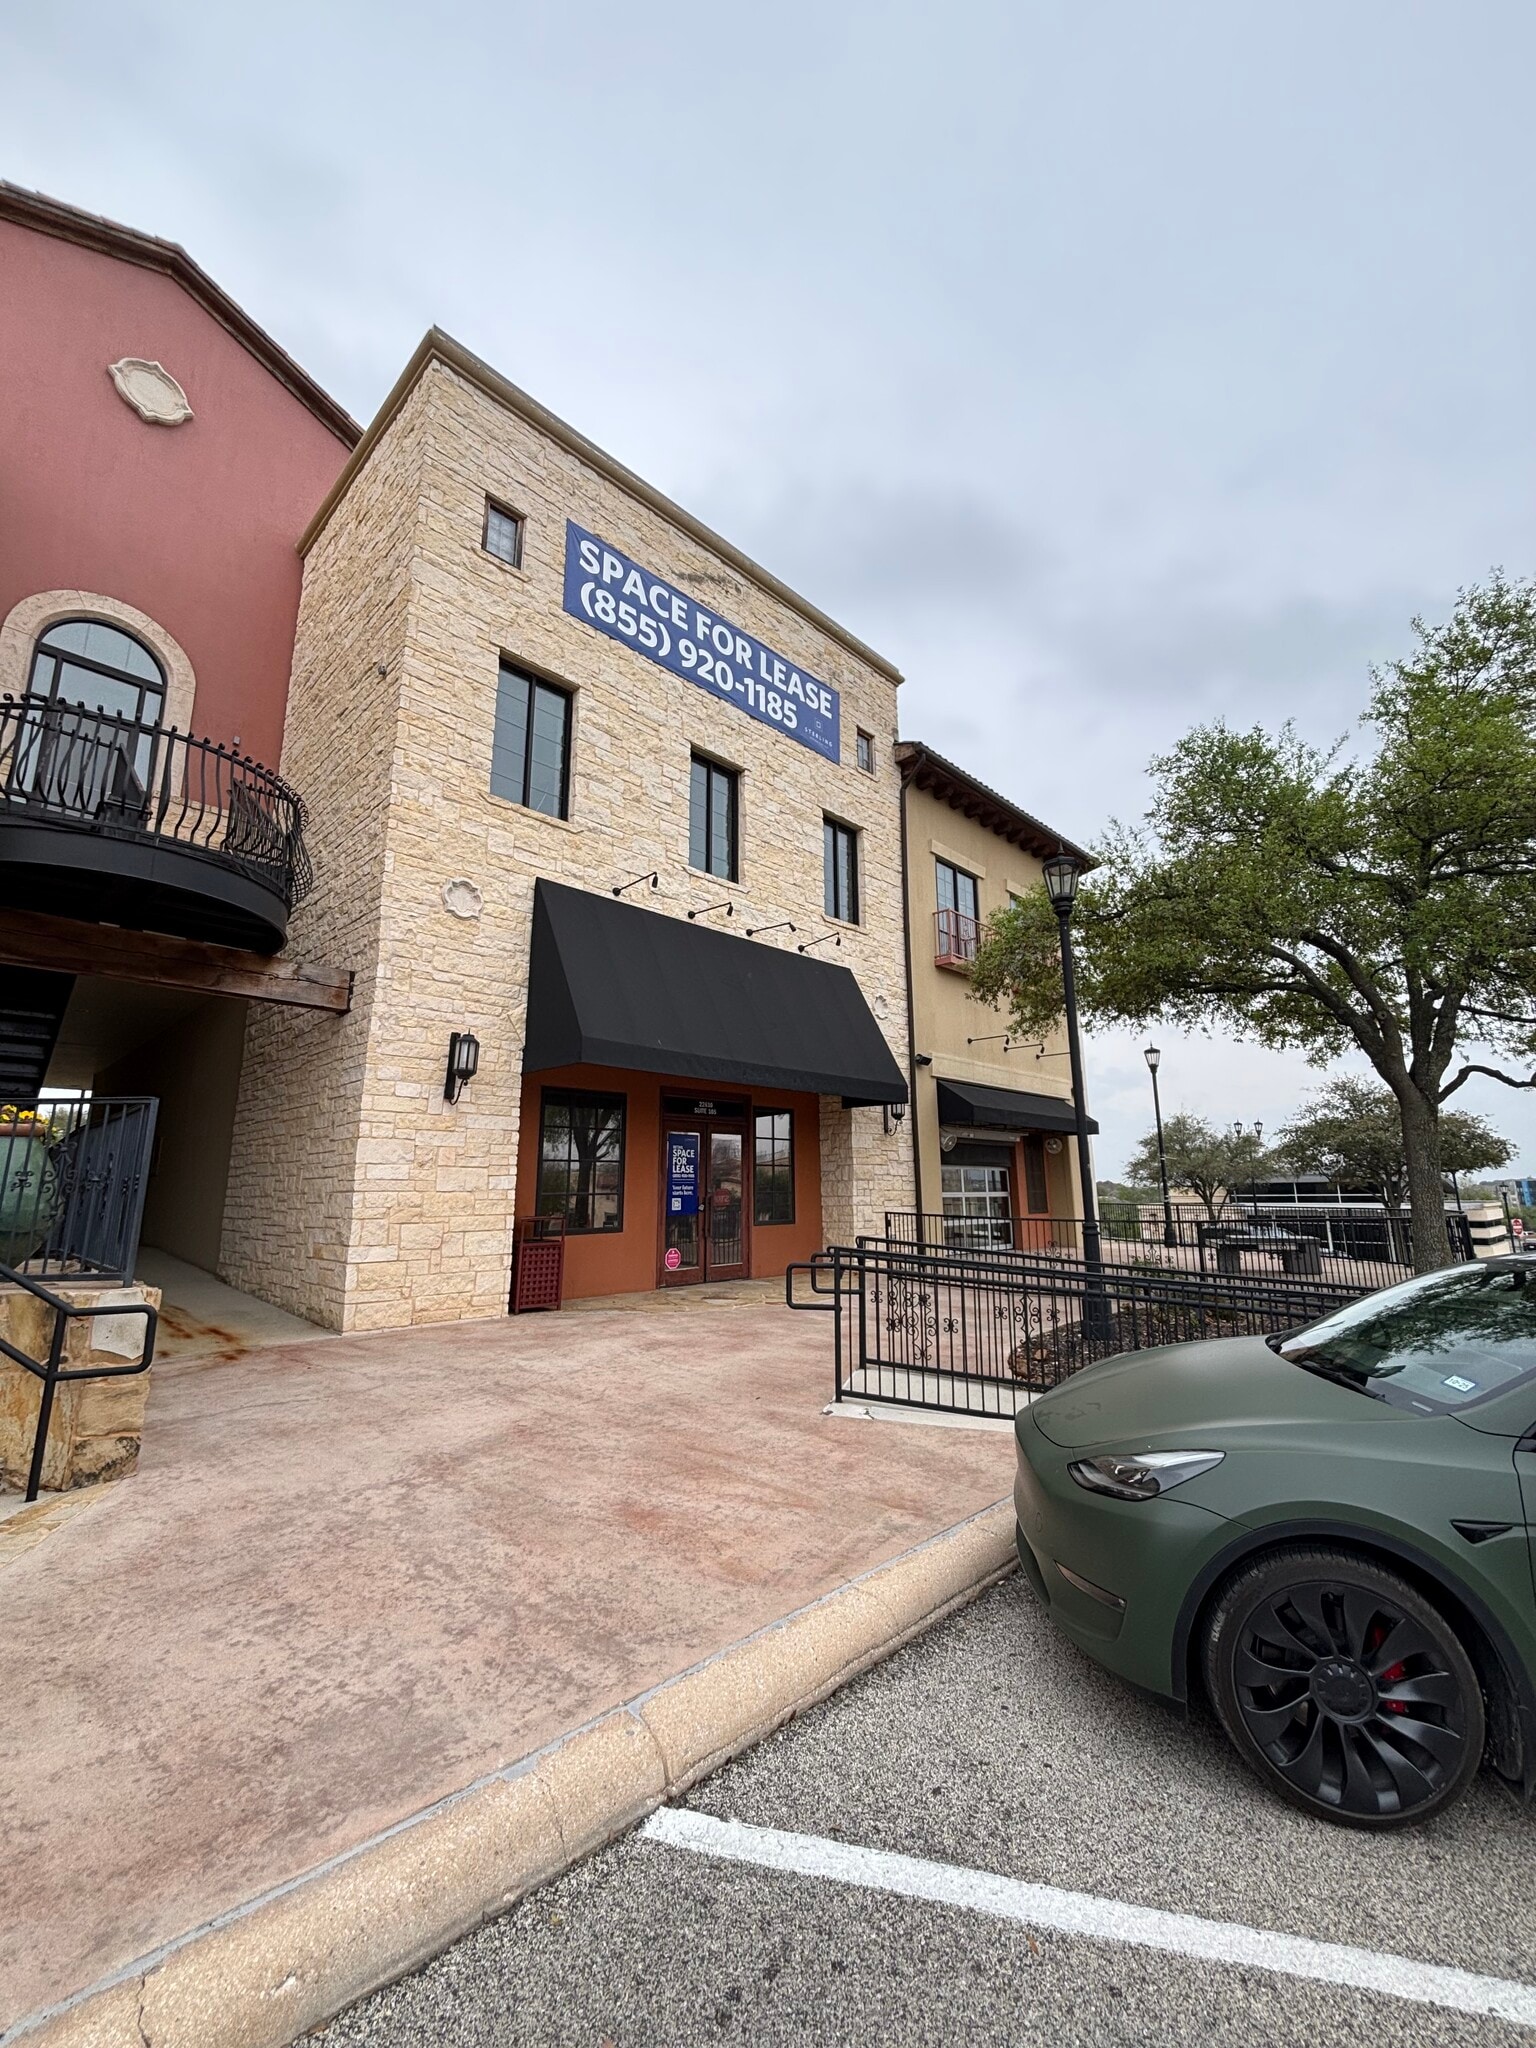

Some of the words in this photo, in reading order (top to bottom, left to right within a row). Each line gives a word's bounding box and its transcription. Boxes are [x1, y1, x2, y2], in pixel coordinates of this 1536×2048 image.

[579, 540, 688, 631] SPACE
[696, 611, 753, 670] FOR
[760, 651, 833, 719] LEASE
[581, 582, 671, 656] (855)
[679, 638, 798, 729] 920-1185
[672, 1149, 695, 1158] SPACE
[672, 1157, 687, 1165] FOR
[672, 1165, 694, 1174] LEASE
